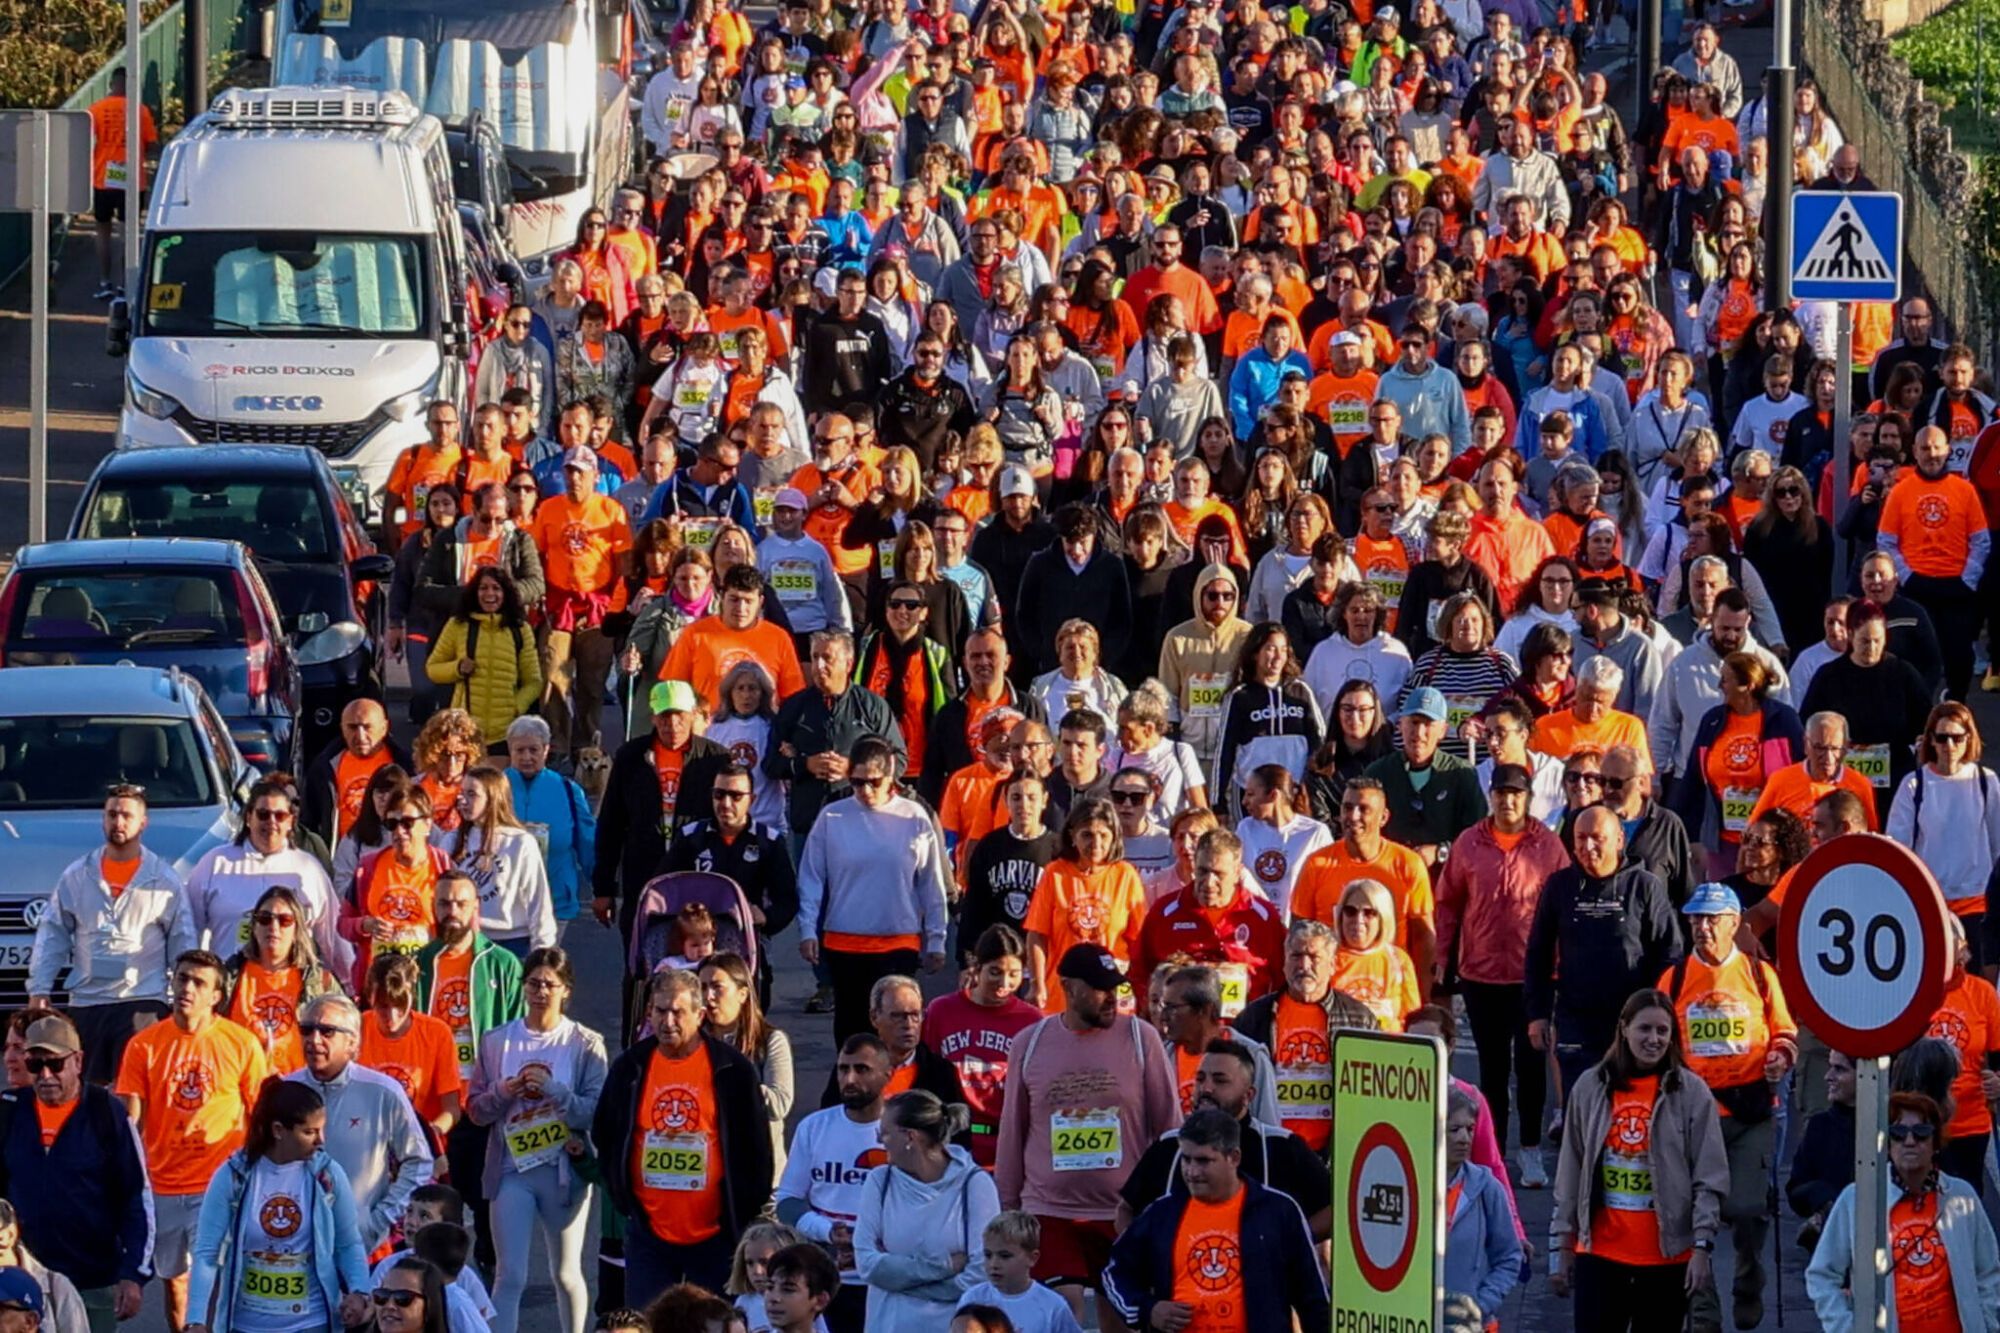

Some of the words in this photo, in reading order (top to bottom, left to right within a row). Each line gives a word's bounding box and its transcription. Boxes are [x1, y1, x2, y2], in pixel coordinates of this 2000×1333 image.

[774, 576, 812, 589] 3335
[1371, 582, 1403, 597] 113
[1250, 703, 1305, 722] adidas
[1726, 803, 1755, 818] 22
[1817, 908, 1907, 983] 30
[1691, 1020, 1746, 1041] 2005
[940, 1028, 972, 1059] NEW
[1339, 1057, 1431, 1103] ATENCIÓN
[1277, 1083, 1333, 1102] 2040
[514, 1123, 566, 1153] 3212
[1057, 1131, 1114, 1152] 2667
[646, 1151, 702, 1172] 2052
[1606, 1170, 1653, 1192] 3132
[246, 1271, 306, 1296] 3083
